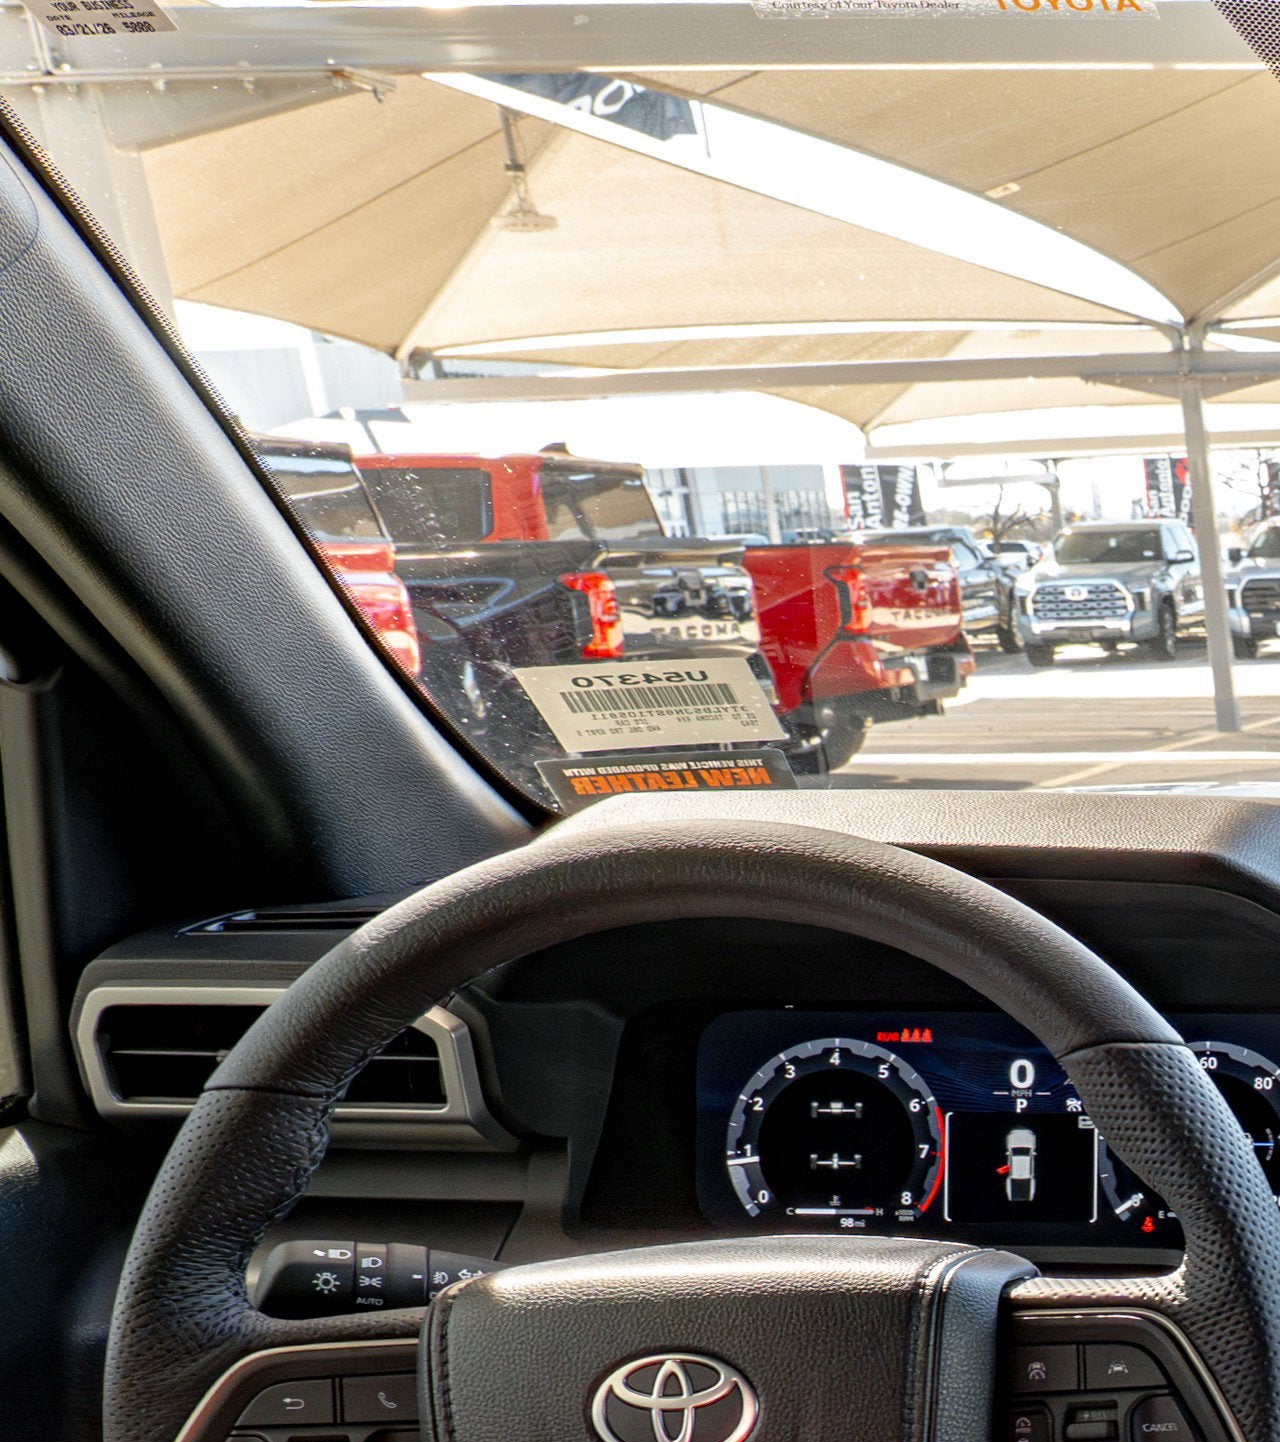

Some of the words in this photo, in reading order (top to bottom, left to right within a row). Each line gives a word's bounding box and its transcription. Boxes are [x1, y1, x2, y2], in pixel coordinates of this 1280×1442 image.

[50, 0, 80, 12] YOUR
[81, 0, 135, 12] BUSINESS
[46, 14, 73, 22] DATE
[111, 11, 157, 19] MILEAGE
[861, 465, 884, 530] Anton
[847, 490, 866, 531] San
[829, 1051, 841, 1066] 4
[1199, 1057, 1218, 1070] 60
[784, 1064, 796, 1079] 3
[878, 1064, 889, 1079] 5
[1009, 1058, 1036, 1089] 0
[1253, 1077, 1273, 1090] 80
[1010, 1089, 1033, 1098] MPH
[752, 1097, 764, 1111] 2
[909, 1098, 921, 1113] 6
[1016, 1098, 1028, 1113] P
[744, 1143, 752, 1157] 1
[918, 1144, 930, 1159] 7
[758, 1189, 770, 1204] 0
[900, 1191, 912, 1205] 8
[786, 1207, 794, 1216] C
[875, 1208, 884, 1216] H
[1158, 1210, 1166, 1219] E
[356, 1297, 384, 1307] AUTO
[1141, 1422, 1179, 1433] CANCEL
